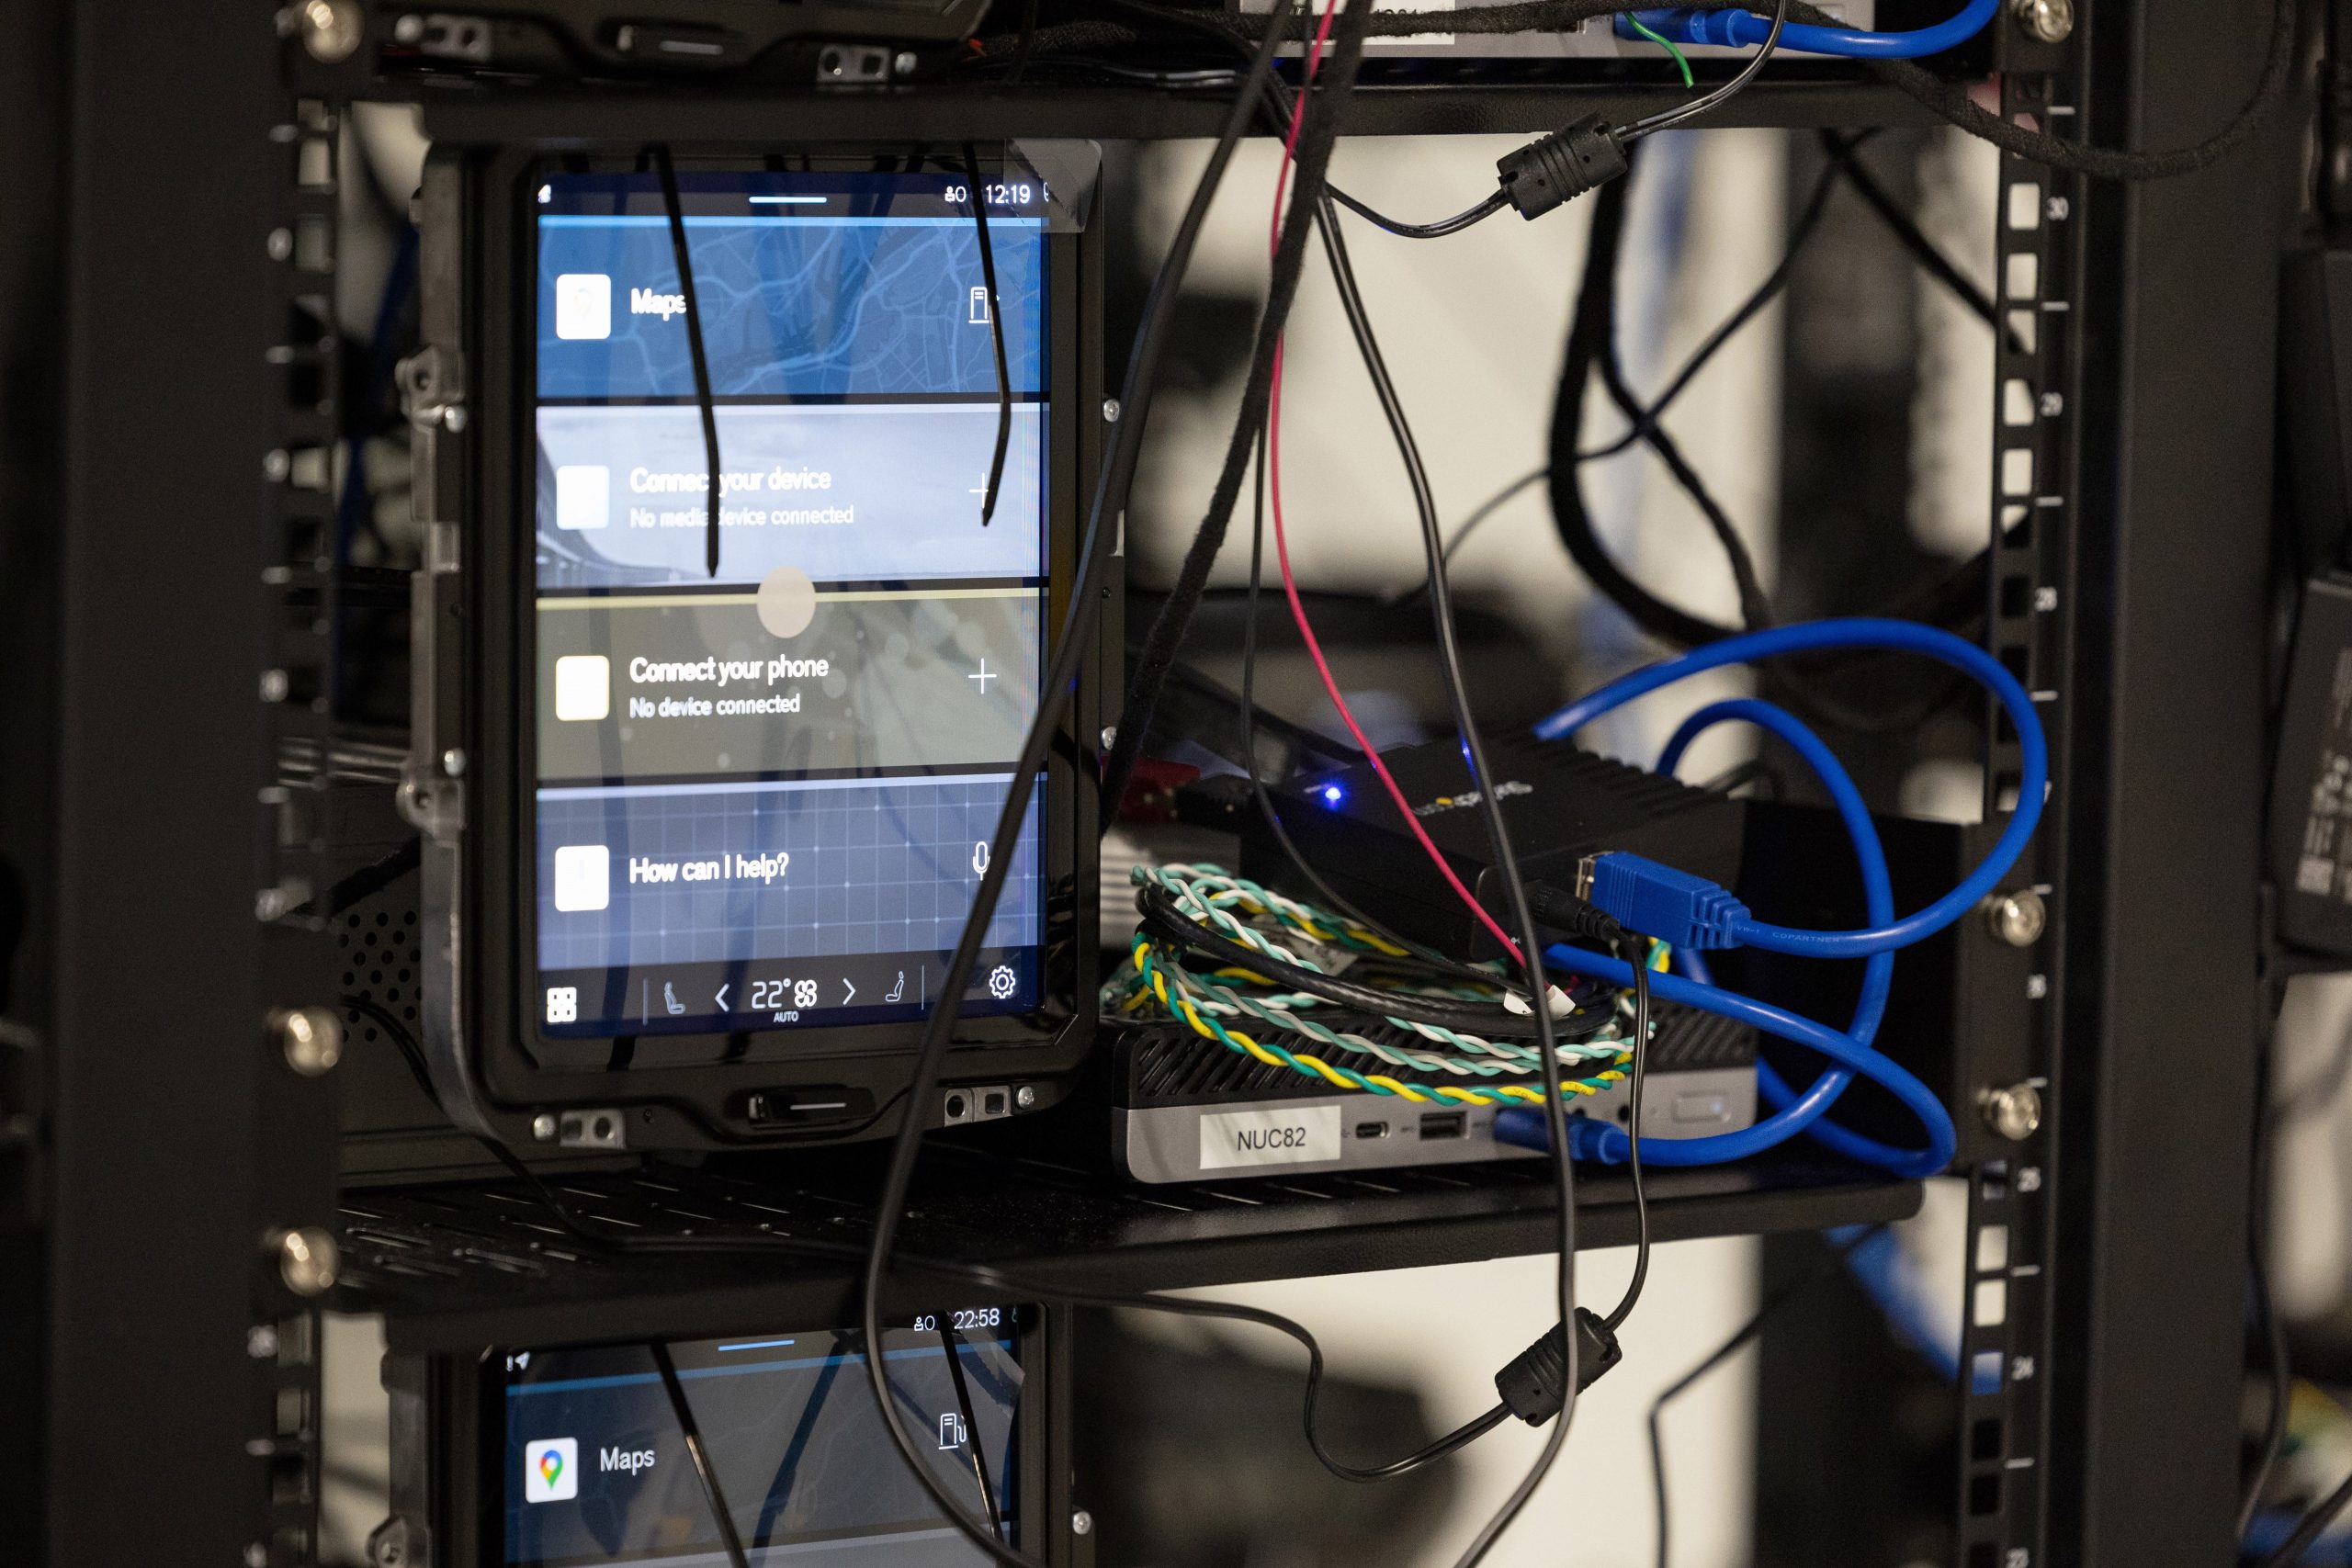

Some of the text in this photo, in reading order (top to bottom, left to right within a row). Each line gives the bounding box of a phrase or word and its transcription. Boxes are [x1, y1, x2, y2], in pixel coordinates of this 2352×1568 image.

[985, 184, 1031, 204] 12:19
[631, 288, 687, 321] Maps
[630, 467, 831, 498] Connec your device
[630, 508, 656, 528] No
[771, 504, 854, 525] connected
[630, 654, 829, 687] Connect your phone
[630, 693, 800, 718] No device connected
[629, 852, 789, 885] How can I help?
[1772, 931, 1839, 943] COPARTNER
[773, 1010, 799, 1023] AUTO
[1237, 1126, 1306, 1151] NUC82
[954, 1307, 1001, 1330] 22:58
[600, 1446, 656, 1476] Maps
